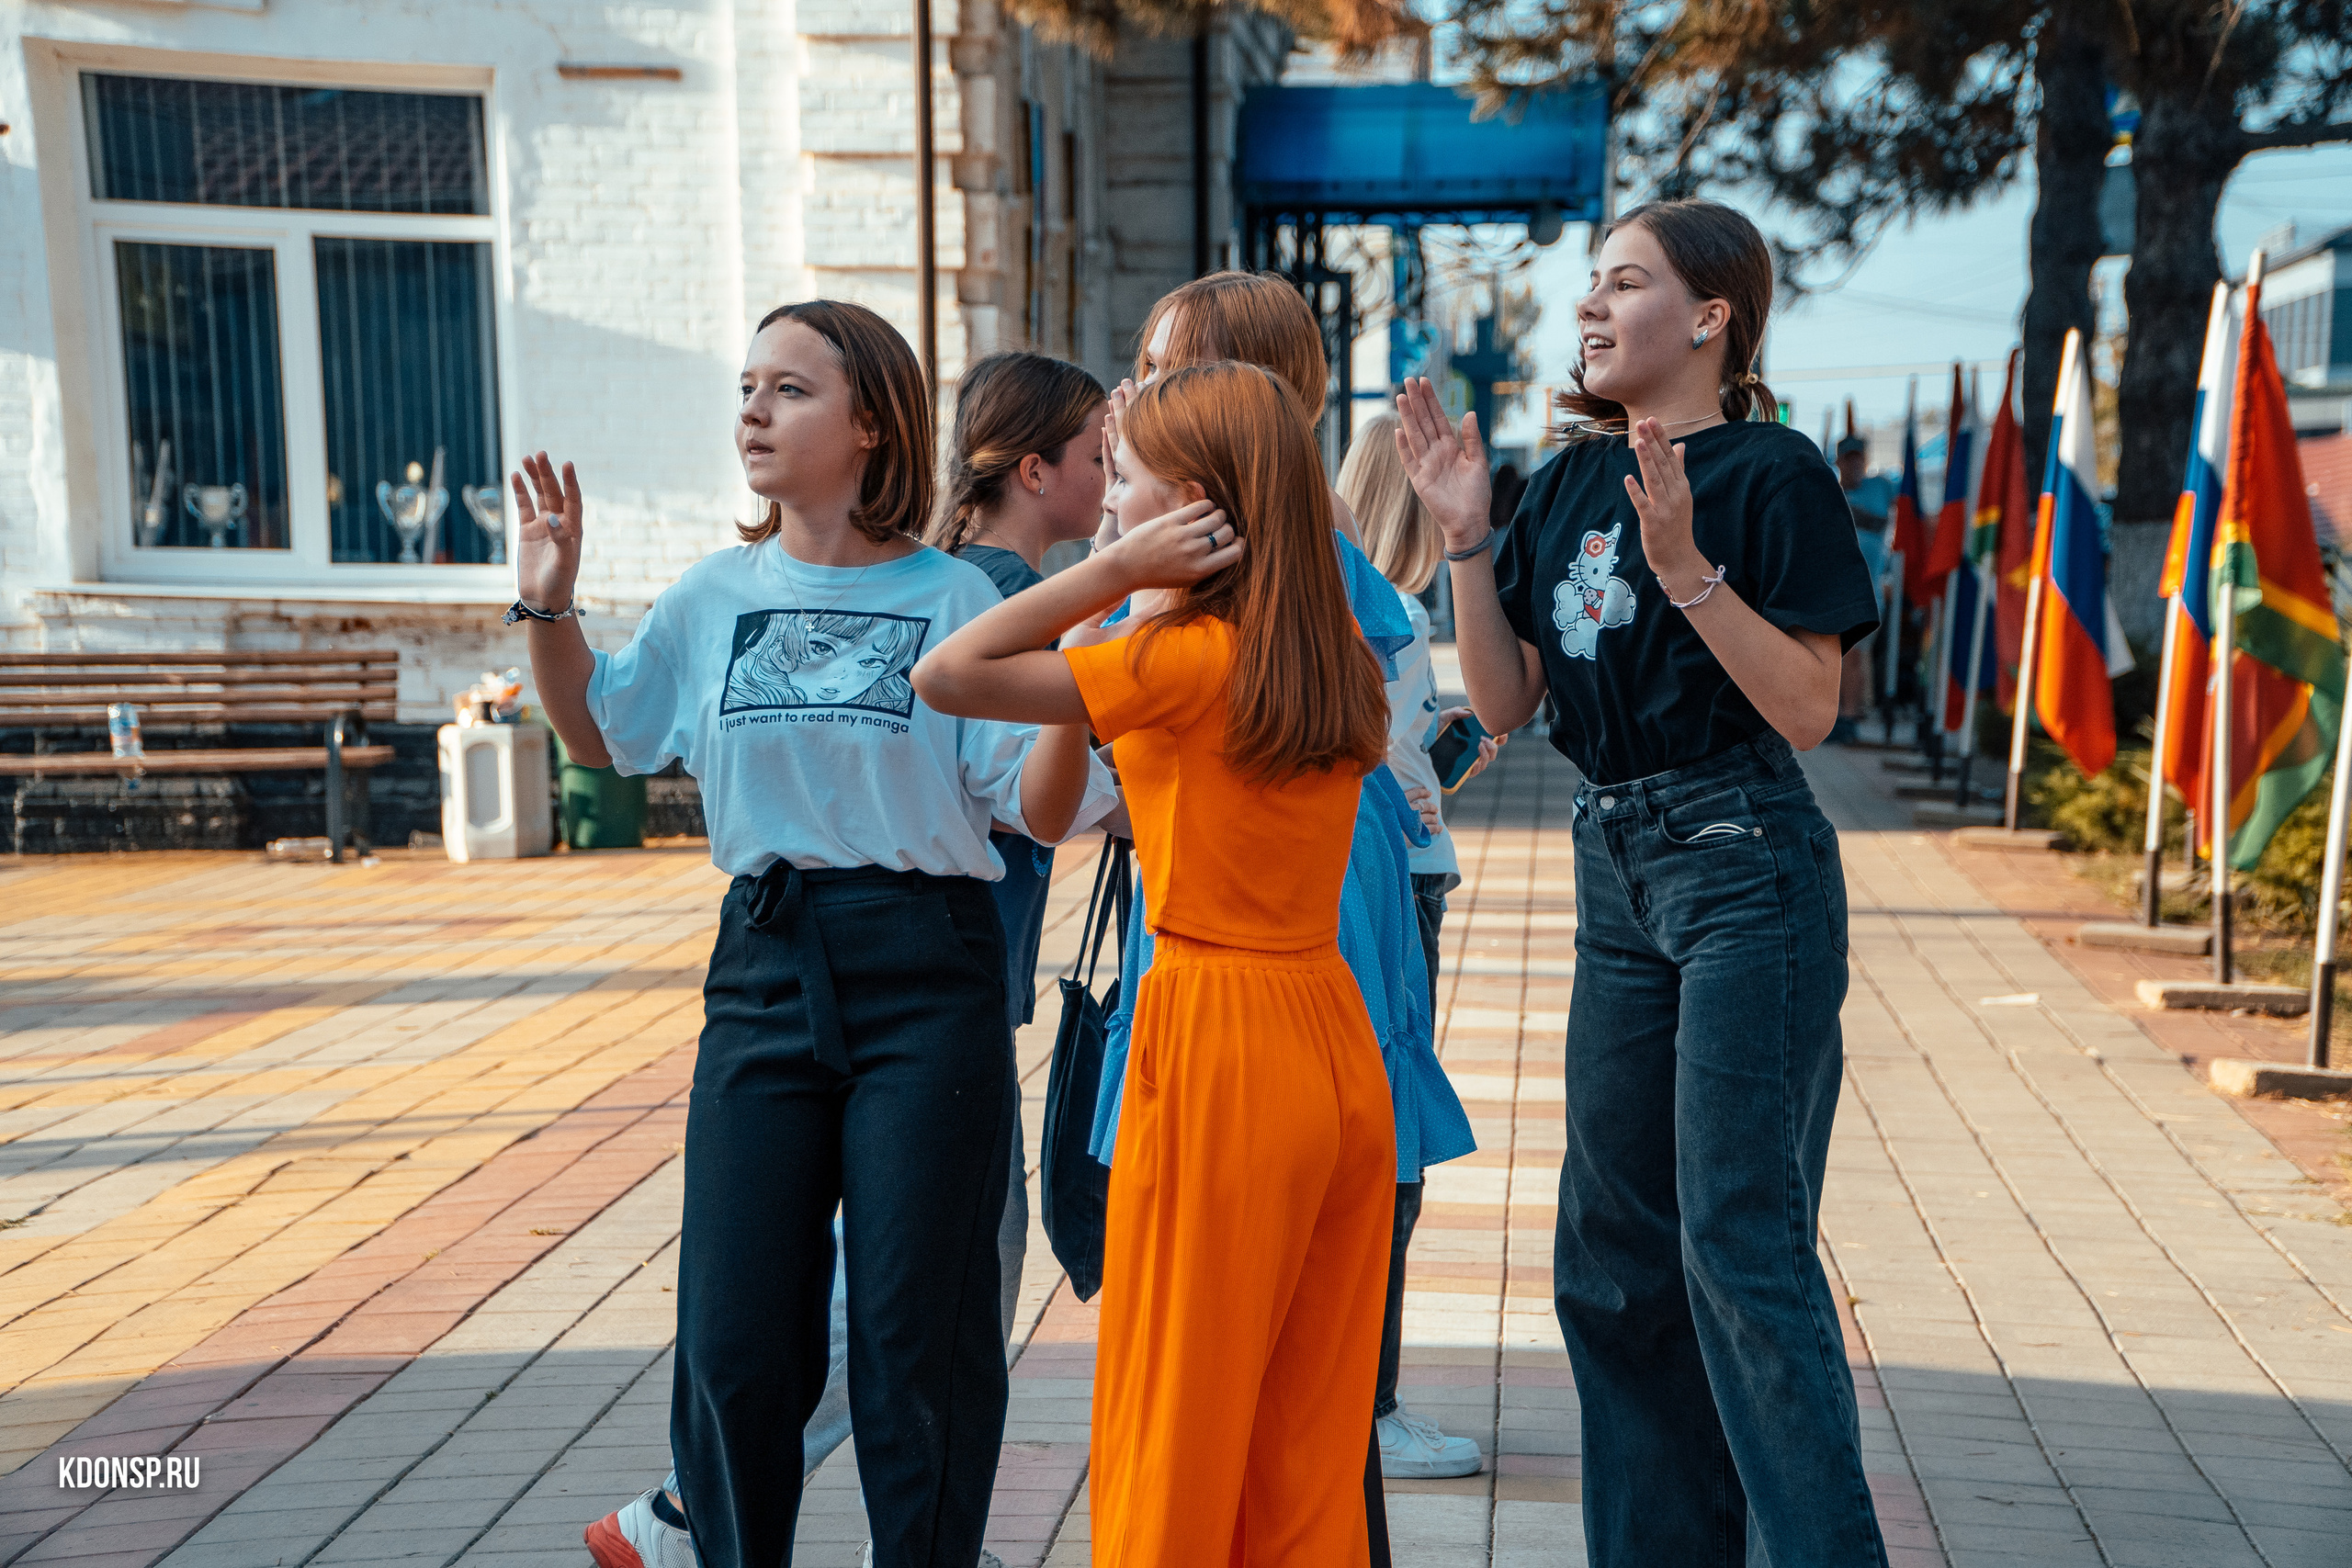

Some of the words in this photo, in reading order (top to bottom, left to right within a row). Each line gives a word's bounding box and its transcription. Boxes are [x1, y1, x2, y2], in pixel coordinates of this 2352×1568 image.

[719, 719, 723, 730] I
[725, 716, 746, 732] just
[749, 713, 783, 724] want
[785, 712, 798, 723] to
[801, 710, 834, 723] read
[838, 714, 859, 727] my
[861, 716, 910, 734] manga
